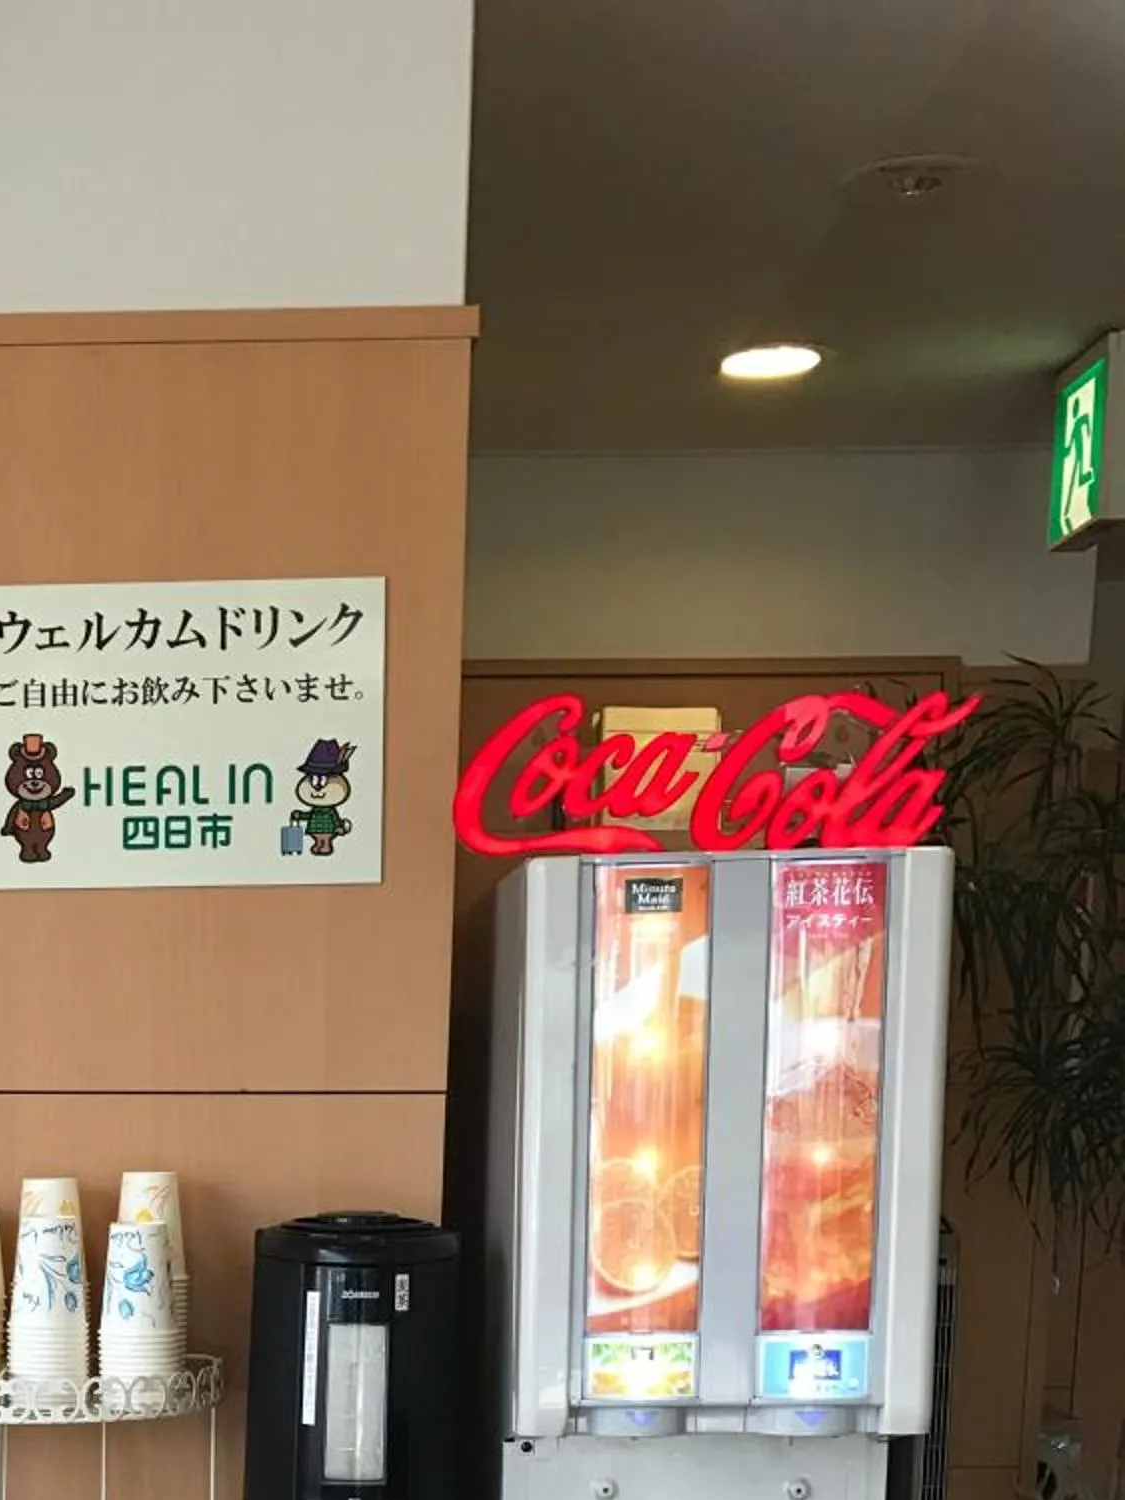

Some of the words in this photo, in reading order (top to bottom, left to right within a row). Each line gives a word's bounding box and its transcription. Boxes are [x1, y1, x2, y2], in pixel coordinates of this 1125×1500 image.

[82, 763, 210, 808] HEAL
[227, 762, 274, 807] IN
[122, 812, 234, 852] 四日市
[785, 876, 874, 908] 紅茶花伝
[785, 913, 874, 928] アイスティー
